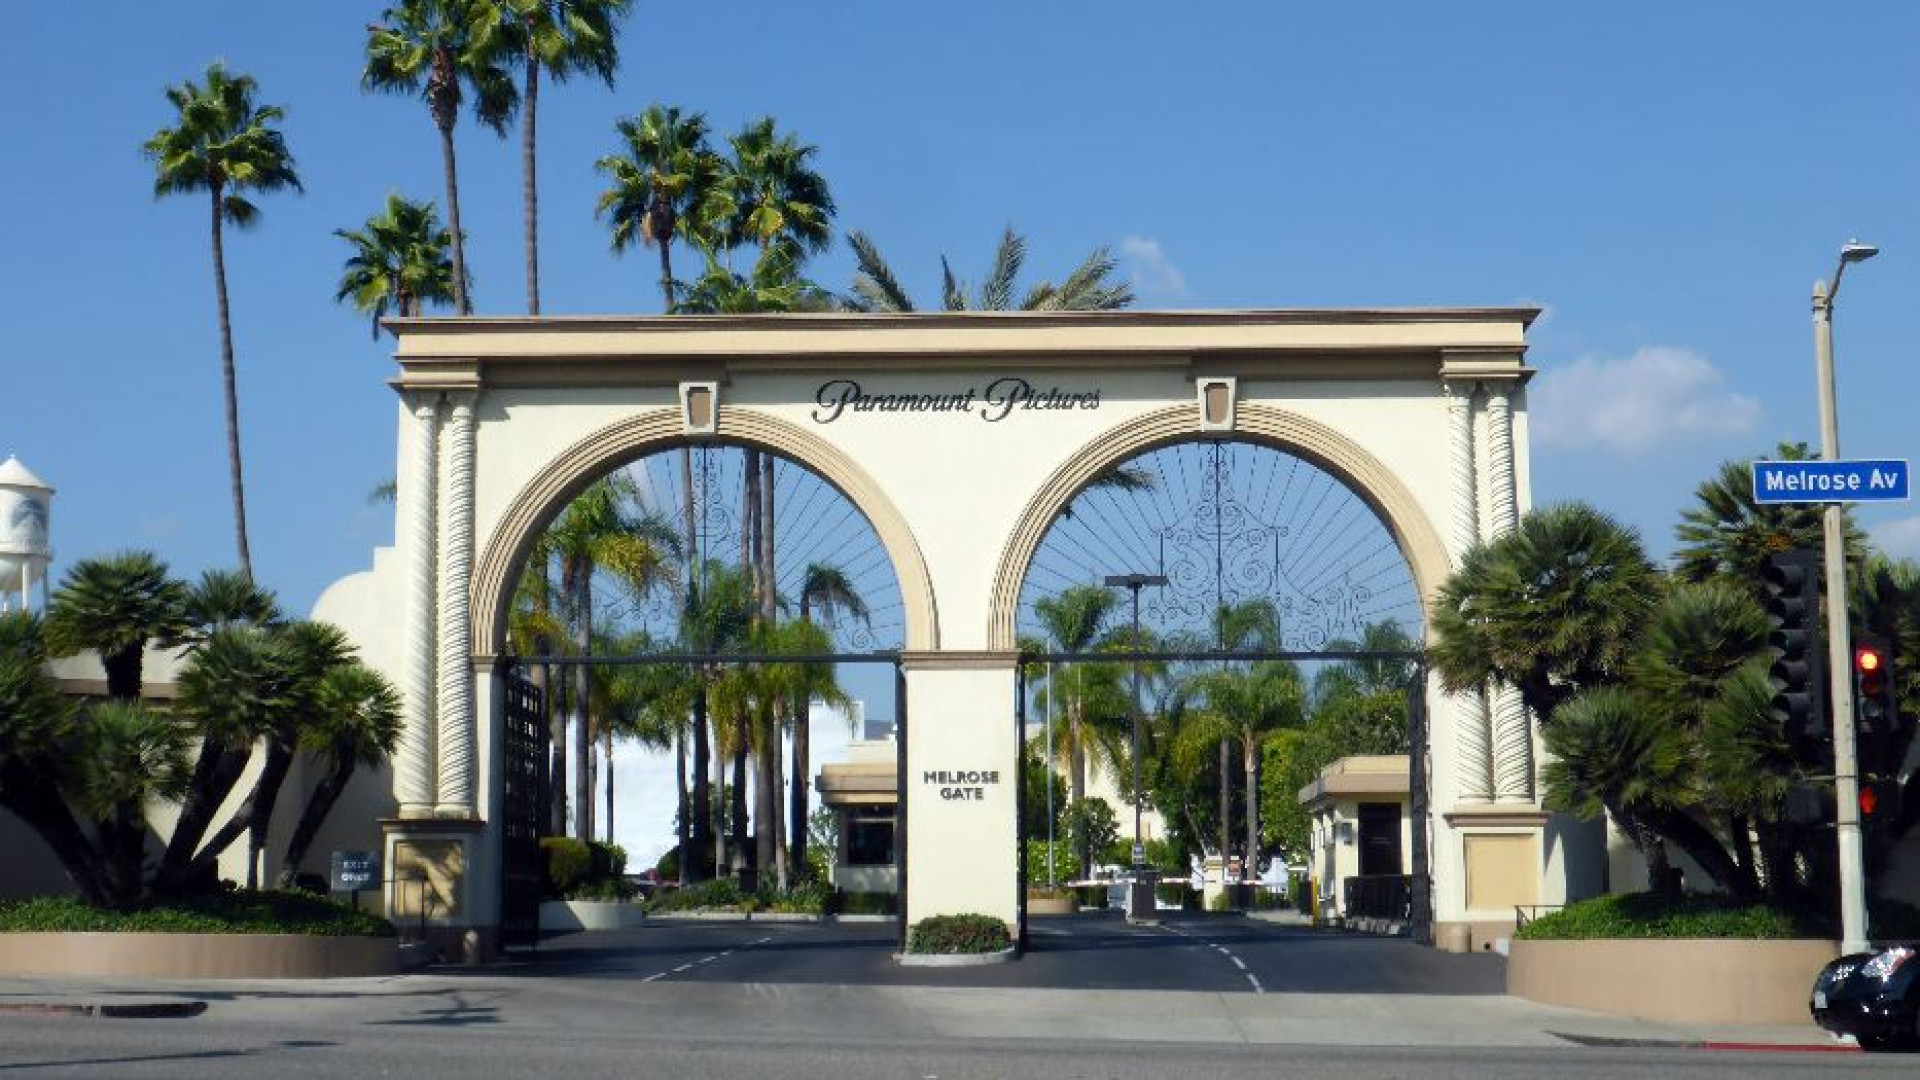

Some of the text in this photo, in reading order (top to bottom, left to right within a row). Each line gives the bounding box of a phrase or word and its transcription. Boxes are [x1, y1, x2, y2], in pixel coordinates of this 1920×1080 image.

[812, 377, 1100, 424] Paramount Pictures
[1765, 468, 1898, 491] Melrose Av
[923, 771, 1000, 784] MELROSE
[940, 787, 984, 800] GATE
[343, 861, 369, 869] EXIT
